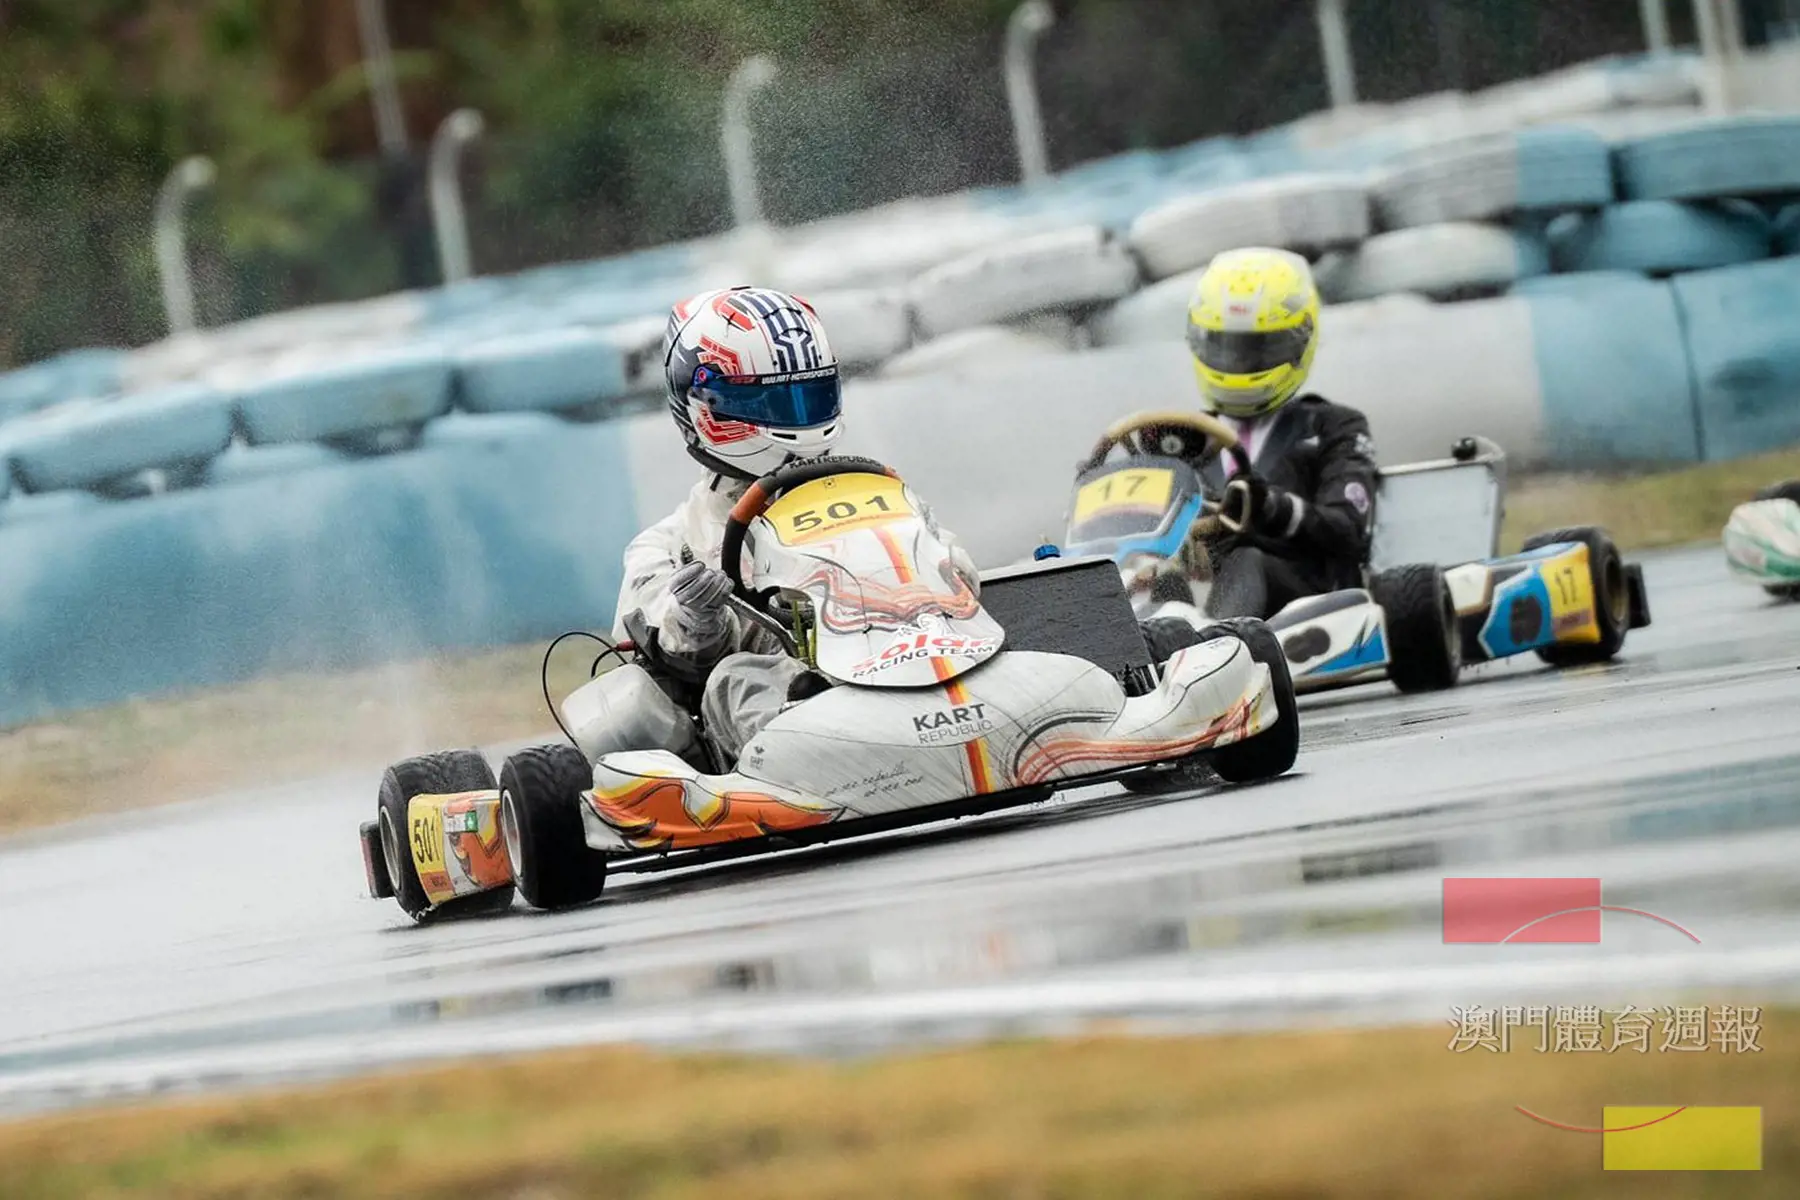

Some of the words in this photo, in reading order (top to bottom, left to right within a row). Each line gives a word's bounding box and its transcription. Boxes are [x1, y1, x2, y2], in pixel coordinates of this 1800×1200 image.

[1098, 475, 1148, 501] 17
[792, 495, 890, 532] 501
[1554, 566, 1577, 605] 17
[852, 650, 929, 678] RACING
[935, 646, 994, 655] TEAM
[912, 703, 985, 731] KART
[918, 720, 993, 744] REPUBLIC
[413, 816, 440, 864] 501
